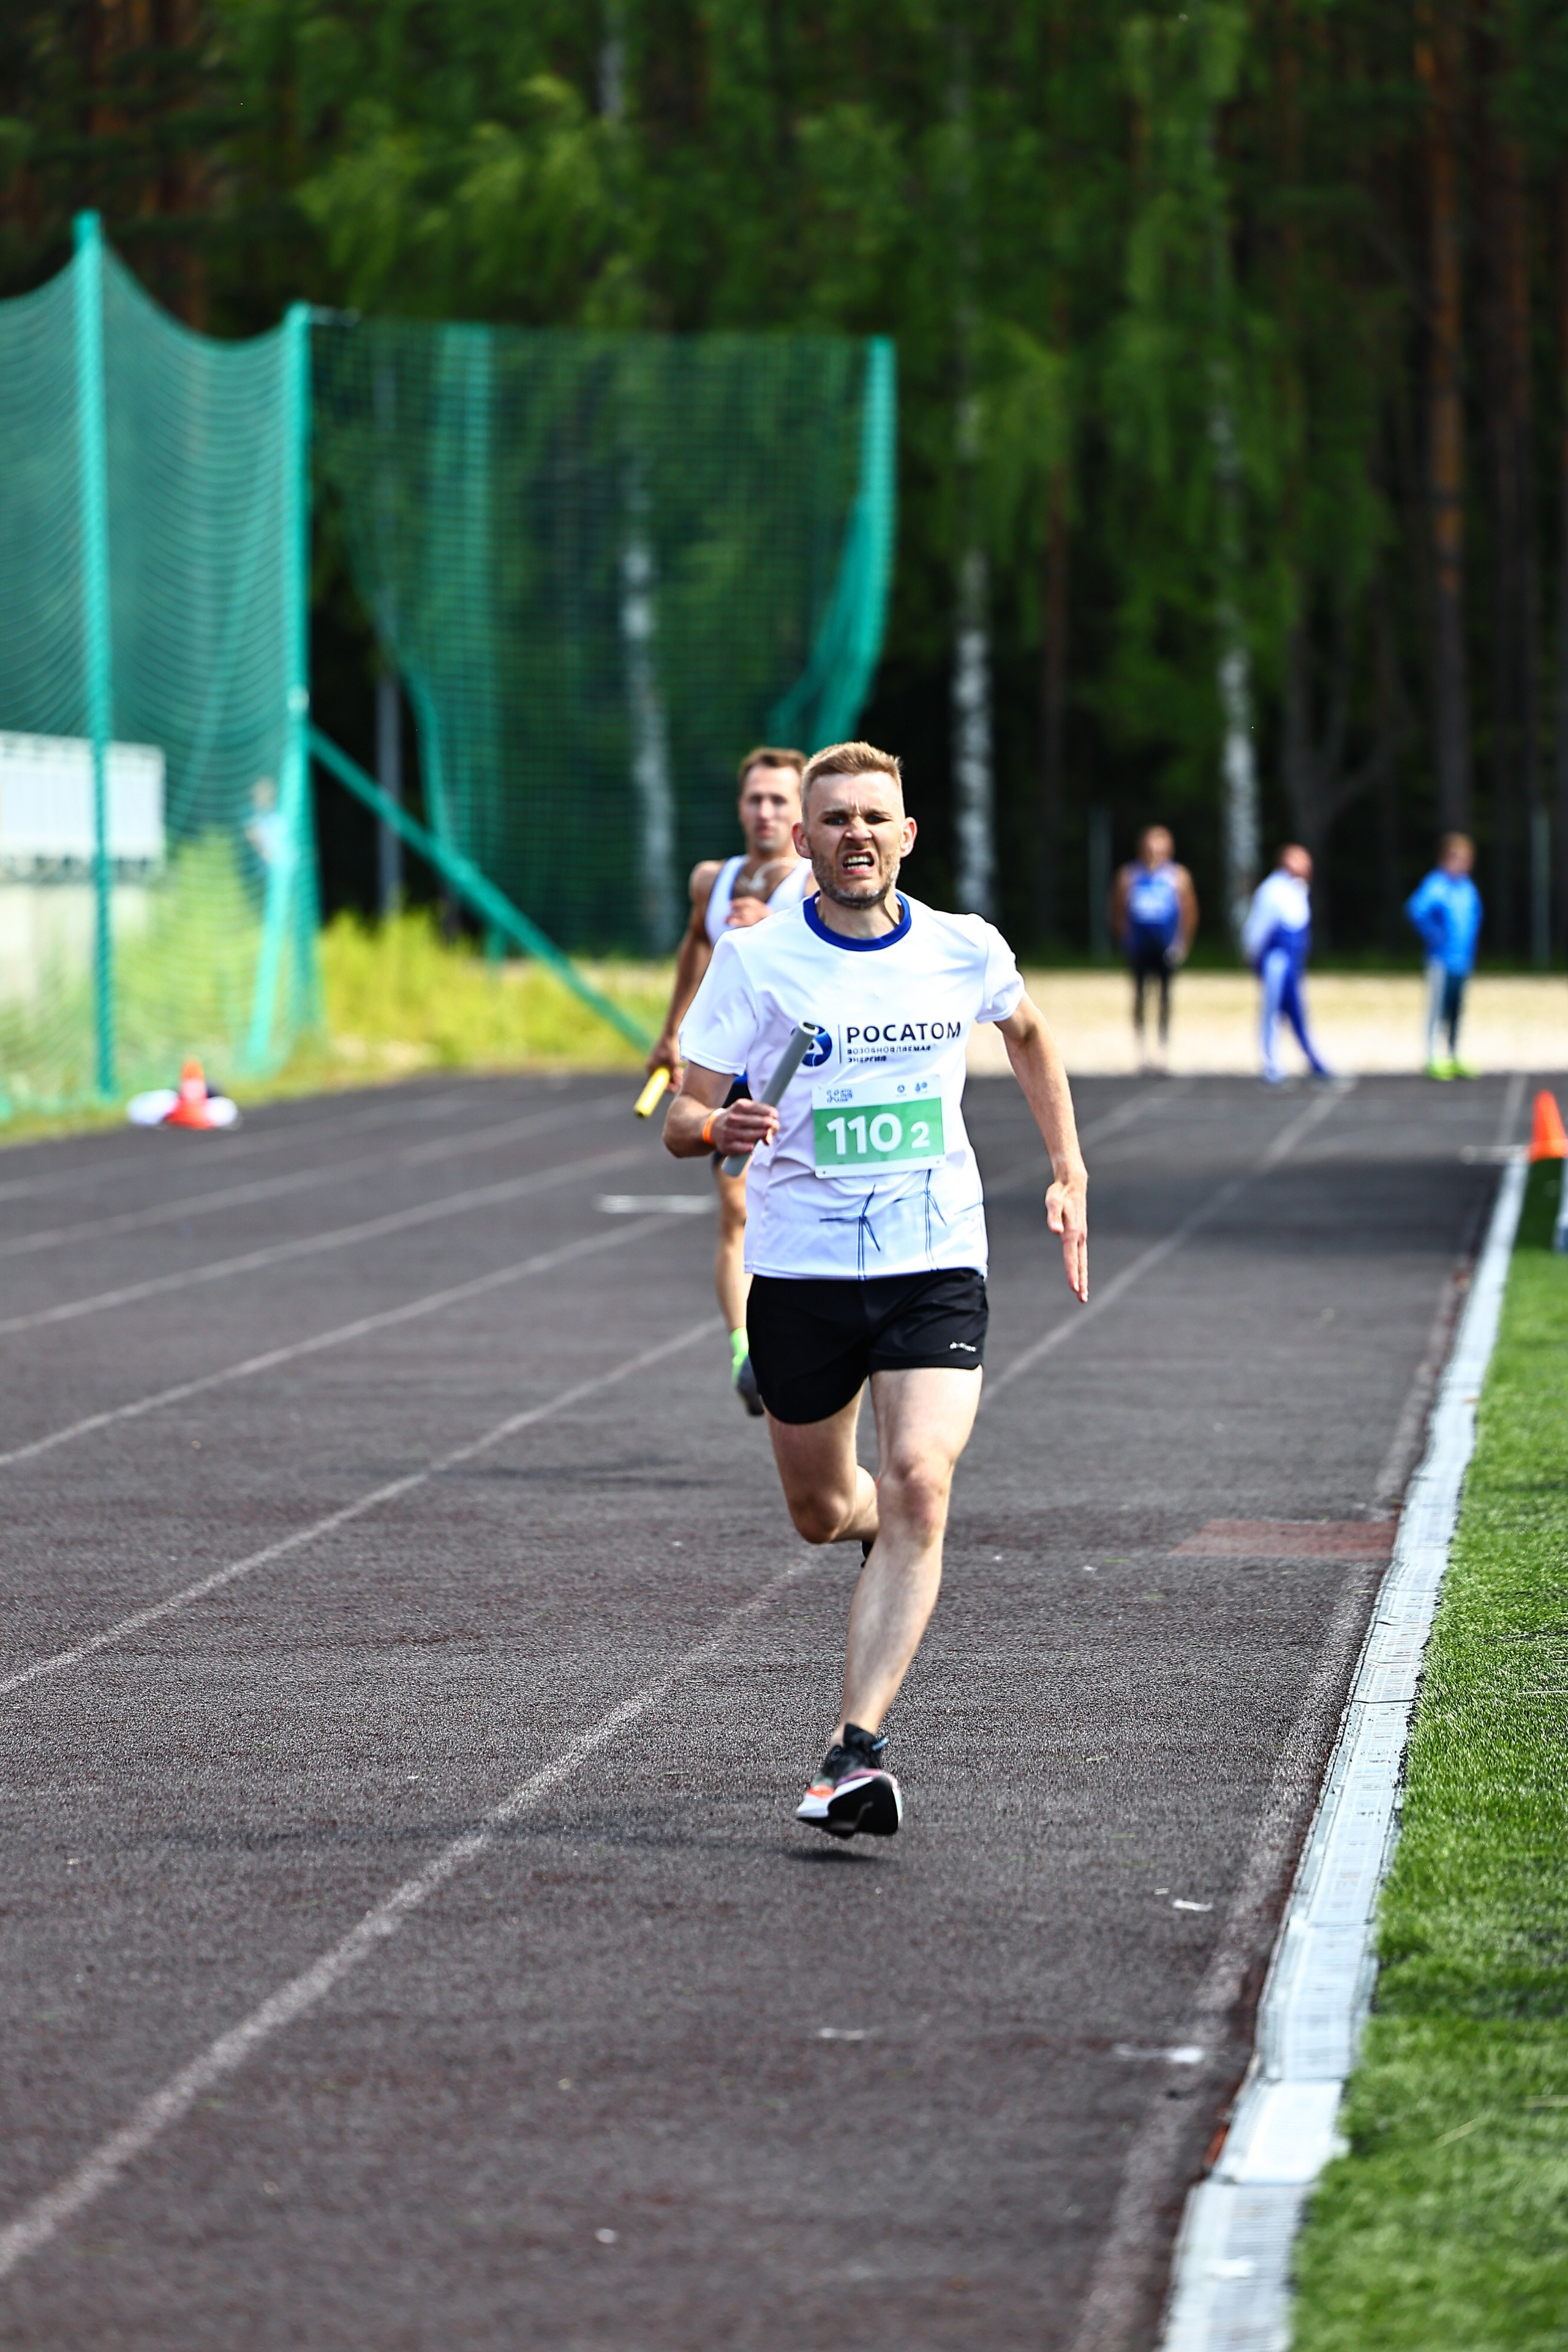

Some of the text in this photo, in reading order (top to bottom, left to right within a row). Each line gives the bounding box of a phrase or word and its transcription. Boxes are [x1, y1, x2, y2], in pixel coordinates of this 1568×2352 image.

[847, 1022, 960, 1044] РОСАТОМ
[826, 1113, 930, 1155] 110 2
